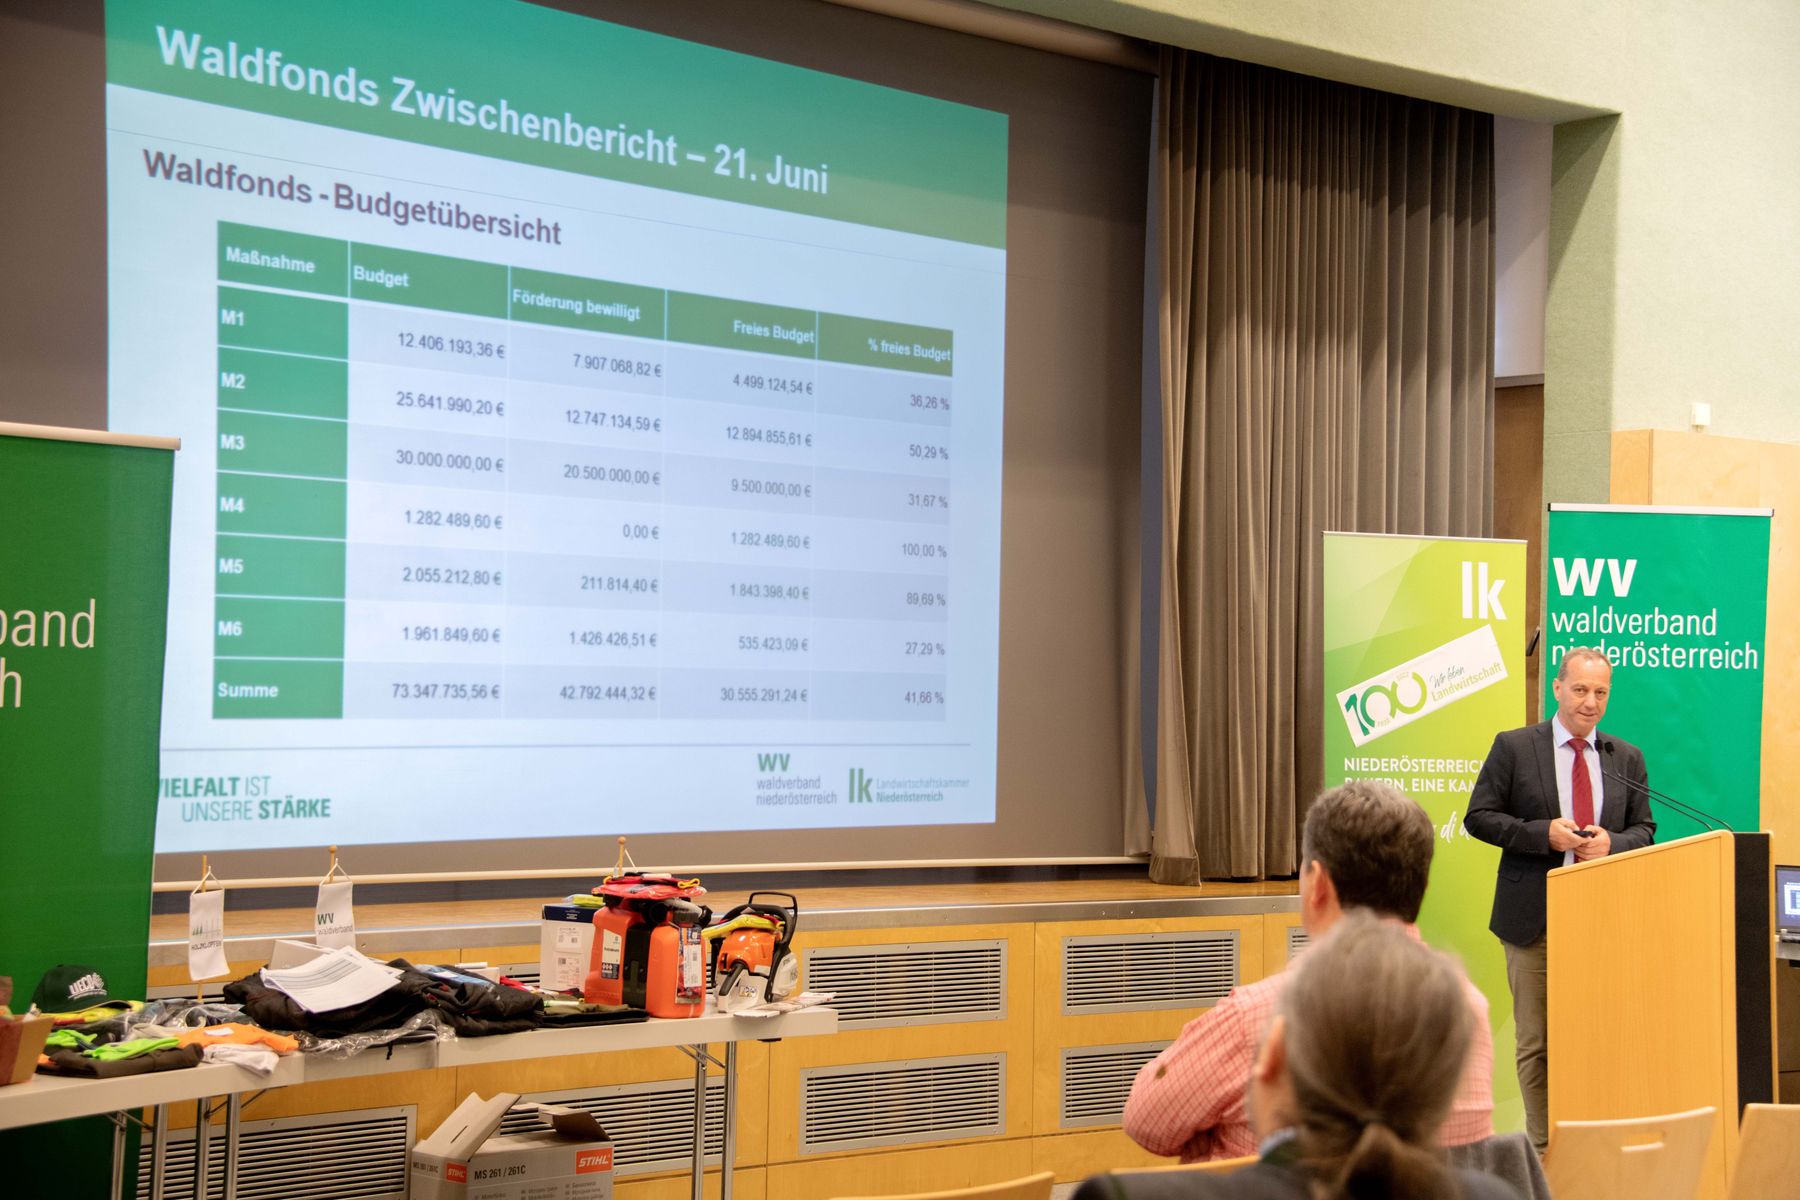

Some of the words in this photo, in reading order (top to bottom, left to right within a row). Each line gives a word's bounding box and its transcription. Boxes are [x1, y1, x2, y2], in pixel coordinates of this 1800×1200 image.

[157, 25, 379, 107] Waldfonds
[391, 76, 677, 166] Zwischenbericht
[714, 144, 757, 181] 21.
[766, 155, 828, 195] Juni
[226, 246, 316, 274] Maßnahme
[354, 265, 409, 288] Budget
[513, 288, 583, 315] Förderung
[586, 298, 641, 321] bewilligt
[222, 310, 245, 327] M1
[733, 320, 771, 338] Freies
[773, 324, 815, 344] Budget
[880, 340, 912, 356] freies
[913, 344, 952, 362] Budget
[222, 373, 246, 390] M2
[221, 434, 245, 450] M3
[220, 497, 244, 513] M4
[219, 559, 243, 574] M5
[218, 621, 242, 636] M6
[1552, 606, 1717, 636] waldverband
[217, 683, 278, 697] Summe
[1431, 662, 1502, 702] Landwirtschaft
[245, 776, 271, 796] IST
[757, 776, 821, 790] waldverband
[1412, 778, 1444, 792] EINE
[756, 791, 837, 805] niederösterreich
[182, 801, 253, 822] UNSERE
[258, 795, 331, 819] STÄRKE
[578, 1155, 609, 1168] STIHL
[447, 1168, 465, 1178] STIHL
[474, 1170, 488, 1180] MS
[489, 1168, 502, 1178] 261
[508, 1165, 526, 1176] 261C
